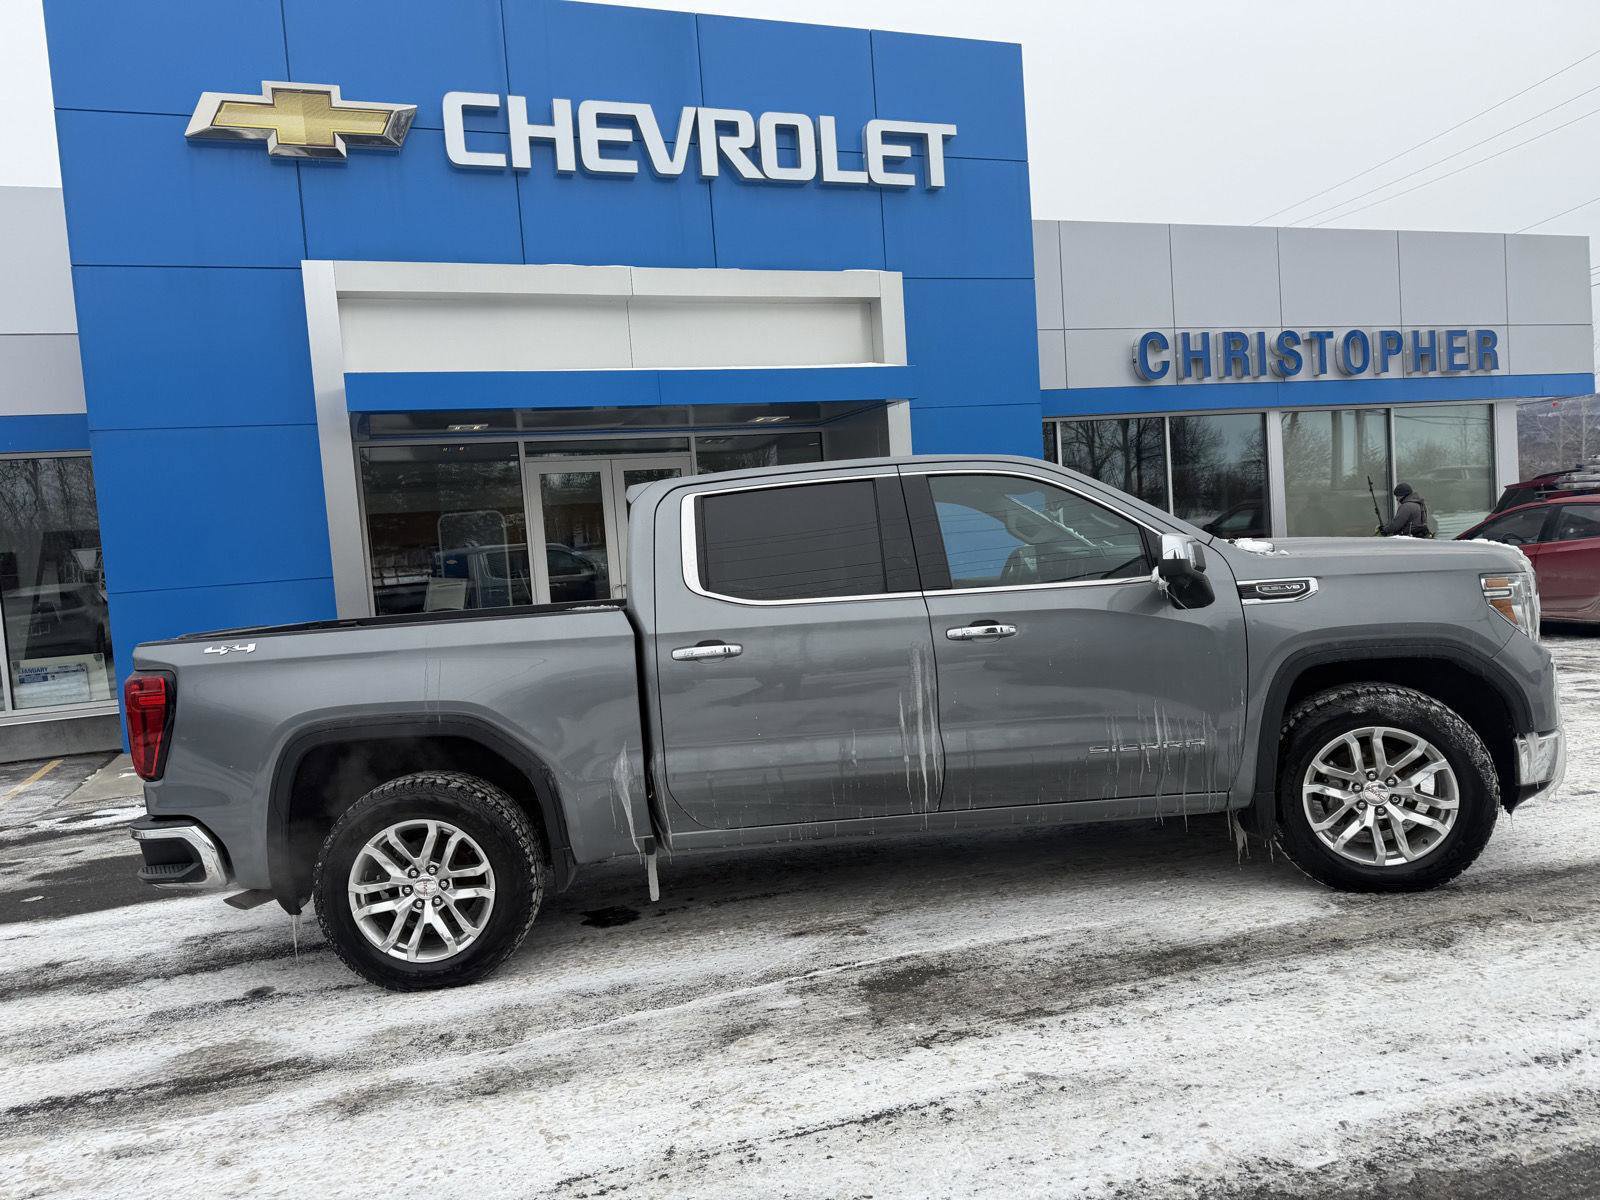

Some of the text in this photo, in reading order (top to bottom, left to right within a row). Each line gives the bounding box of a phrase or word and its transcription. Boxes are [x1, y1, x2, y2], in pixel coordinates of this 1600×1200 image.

[442, 90, 958, 189] CHEVROLET
[1133, 328, 1500, 381] CHRISTOPHER
[1088, 738, 1206, 754] SIERRA
